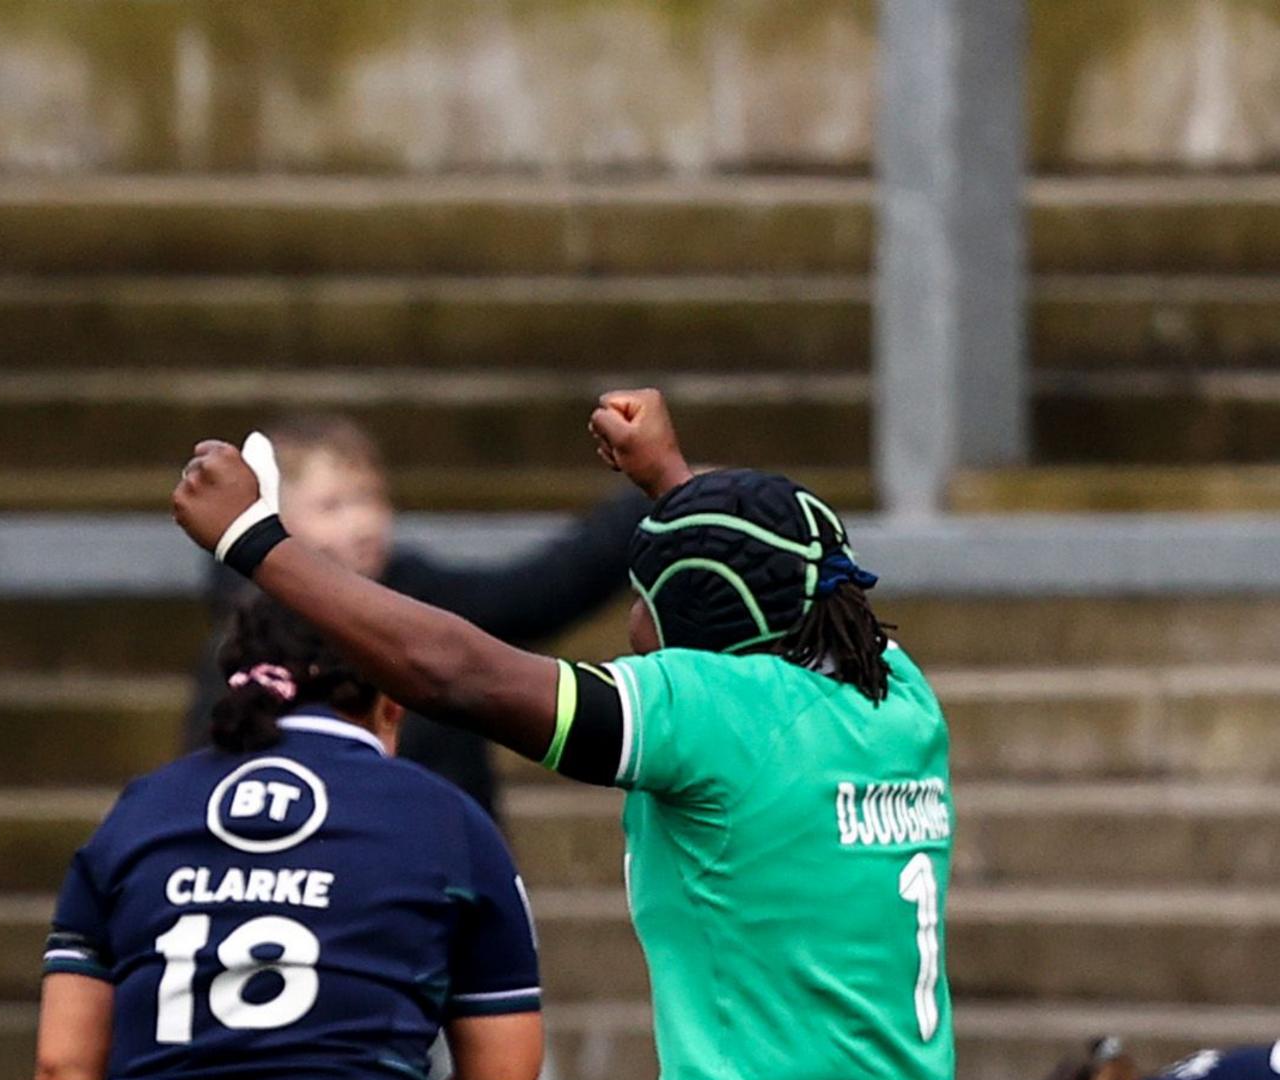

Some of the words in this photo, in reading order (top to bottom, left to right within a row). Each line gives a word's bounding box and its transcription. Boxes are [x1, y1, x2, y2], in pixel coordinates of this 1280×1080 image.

[230, 780, 302, 822] BT
[166, 866, 336, 909] CLARKE
[154, 913, 321, 1045] 18
[899, 852, 938, 1042] 1
